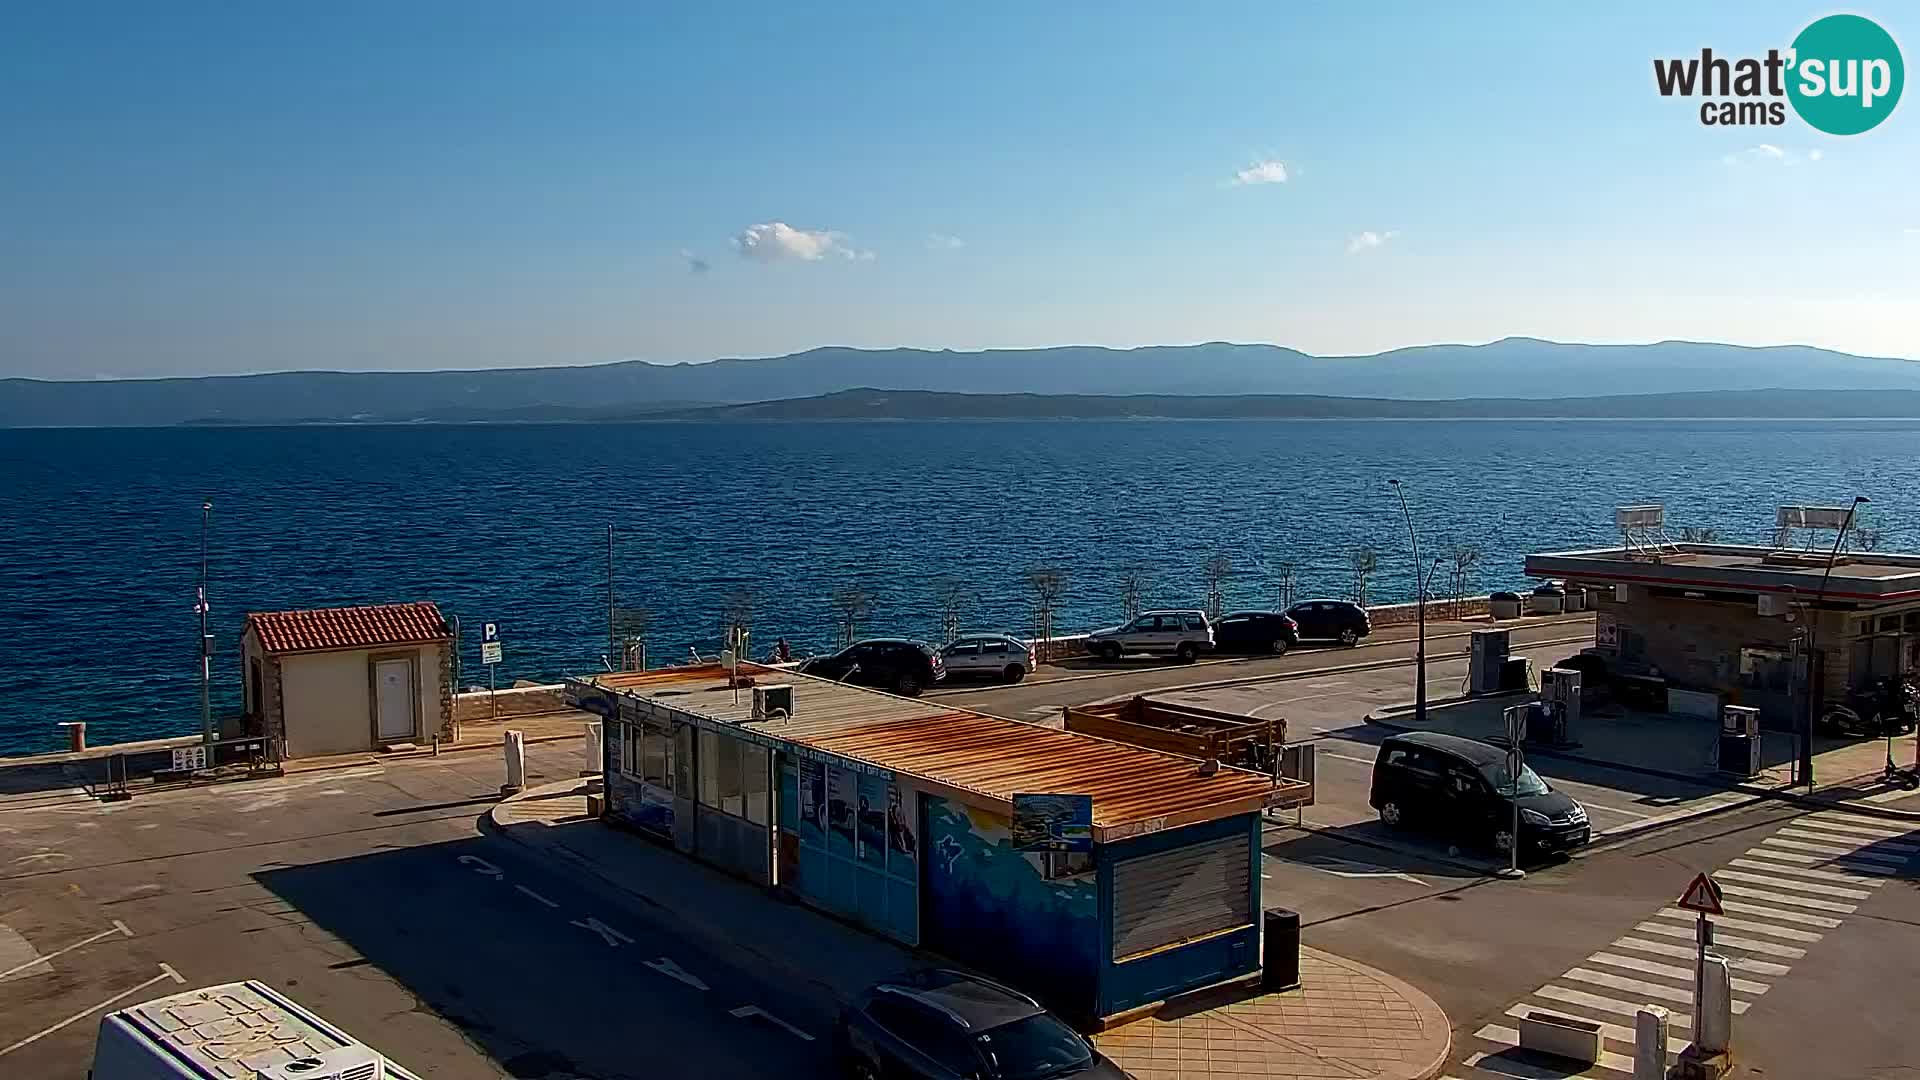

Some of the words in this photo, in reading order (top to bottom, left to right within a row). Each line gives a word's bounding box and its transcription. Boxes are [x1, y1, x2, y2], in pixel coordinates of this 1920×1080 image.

[485, 623, 497, 640] P
[842, 759, 866, 774] TICKET
[867, 765, 892, 781] OFFICE
